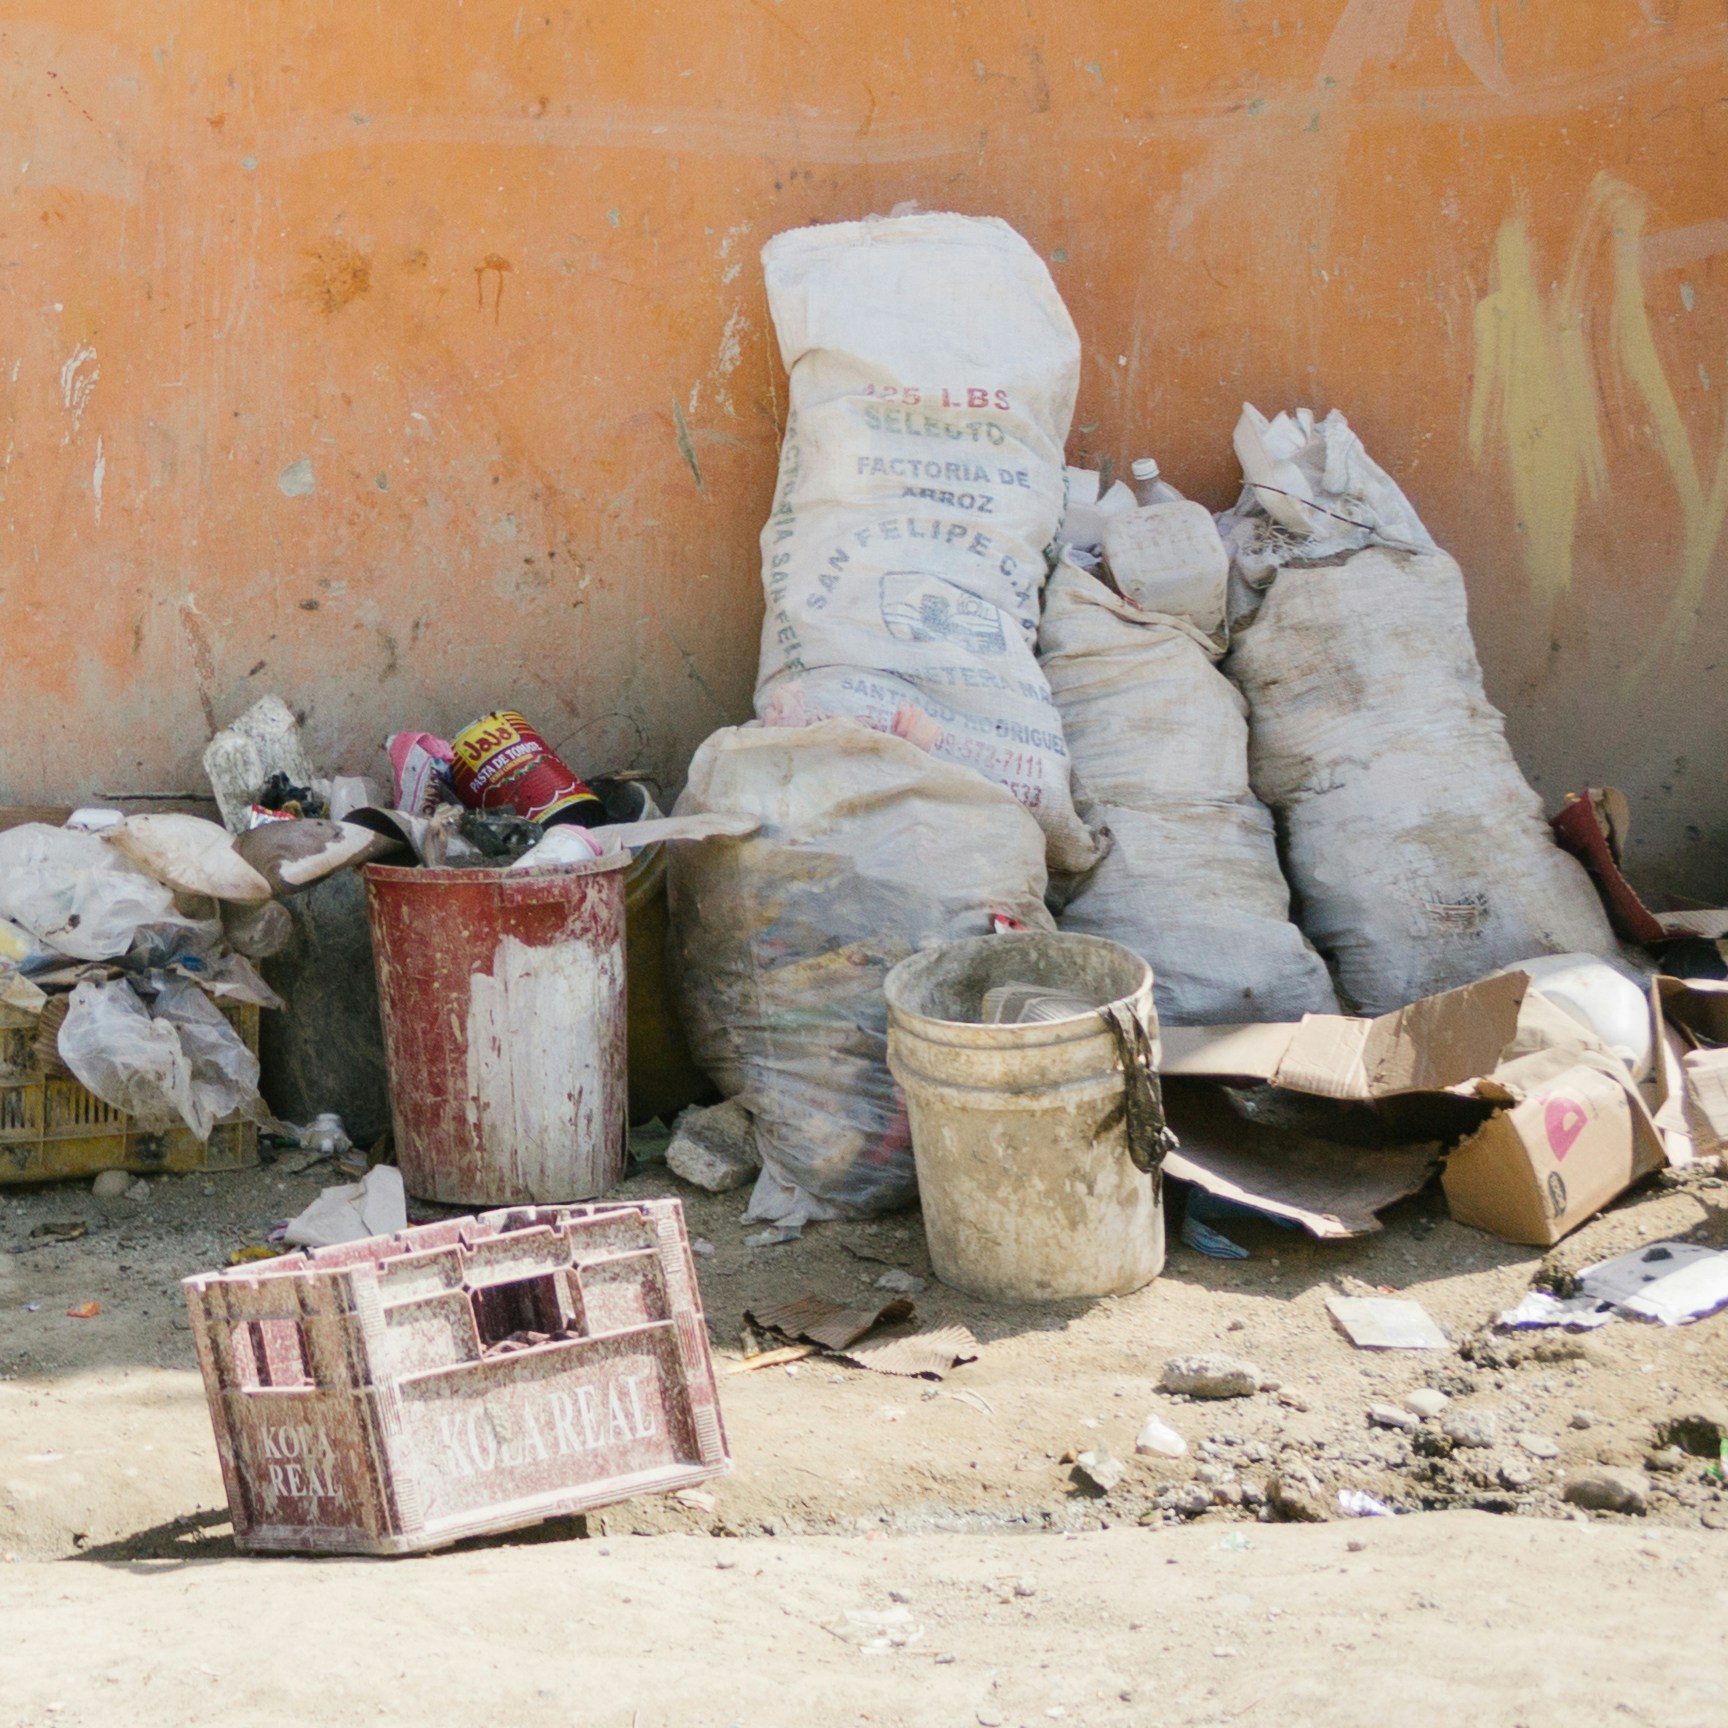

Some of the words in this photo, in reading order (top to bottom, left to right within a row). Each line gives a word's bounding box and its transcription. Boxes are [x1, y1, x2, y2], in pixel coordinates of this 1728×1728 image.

[942, 386, 1011, 411] LBS
[864, 403, 1005, 446] SELECTO
[857, 456, 991, 484] FACTORIA
[997, 468, 1032, 489] DE
[901, 486, 994, 514] ARROZ
[806, 547, 850, 611] SAN
[854, 517, 992, 557] FELIPE
[469, 764, 497, 793] PASTA
[492, 753, 510, 770] DE
[261, 1422, 337, 1462] KOLA
[440, 1403, 547, 1474] KOLA
[549, 1374, 656, 1456] REAL
[268, 1462, 343, 1499] REAL
